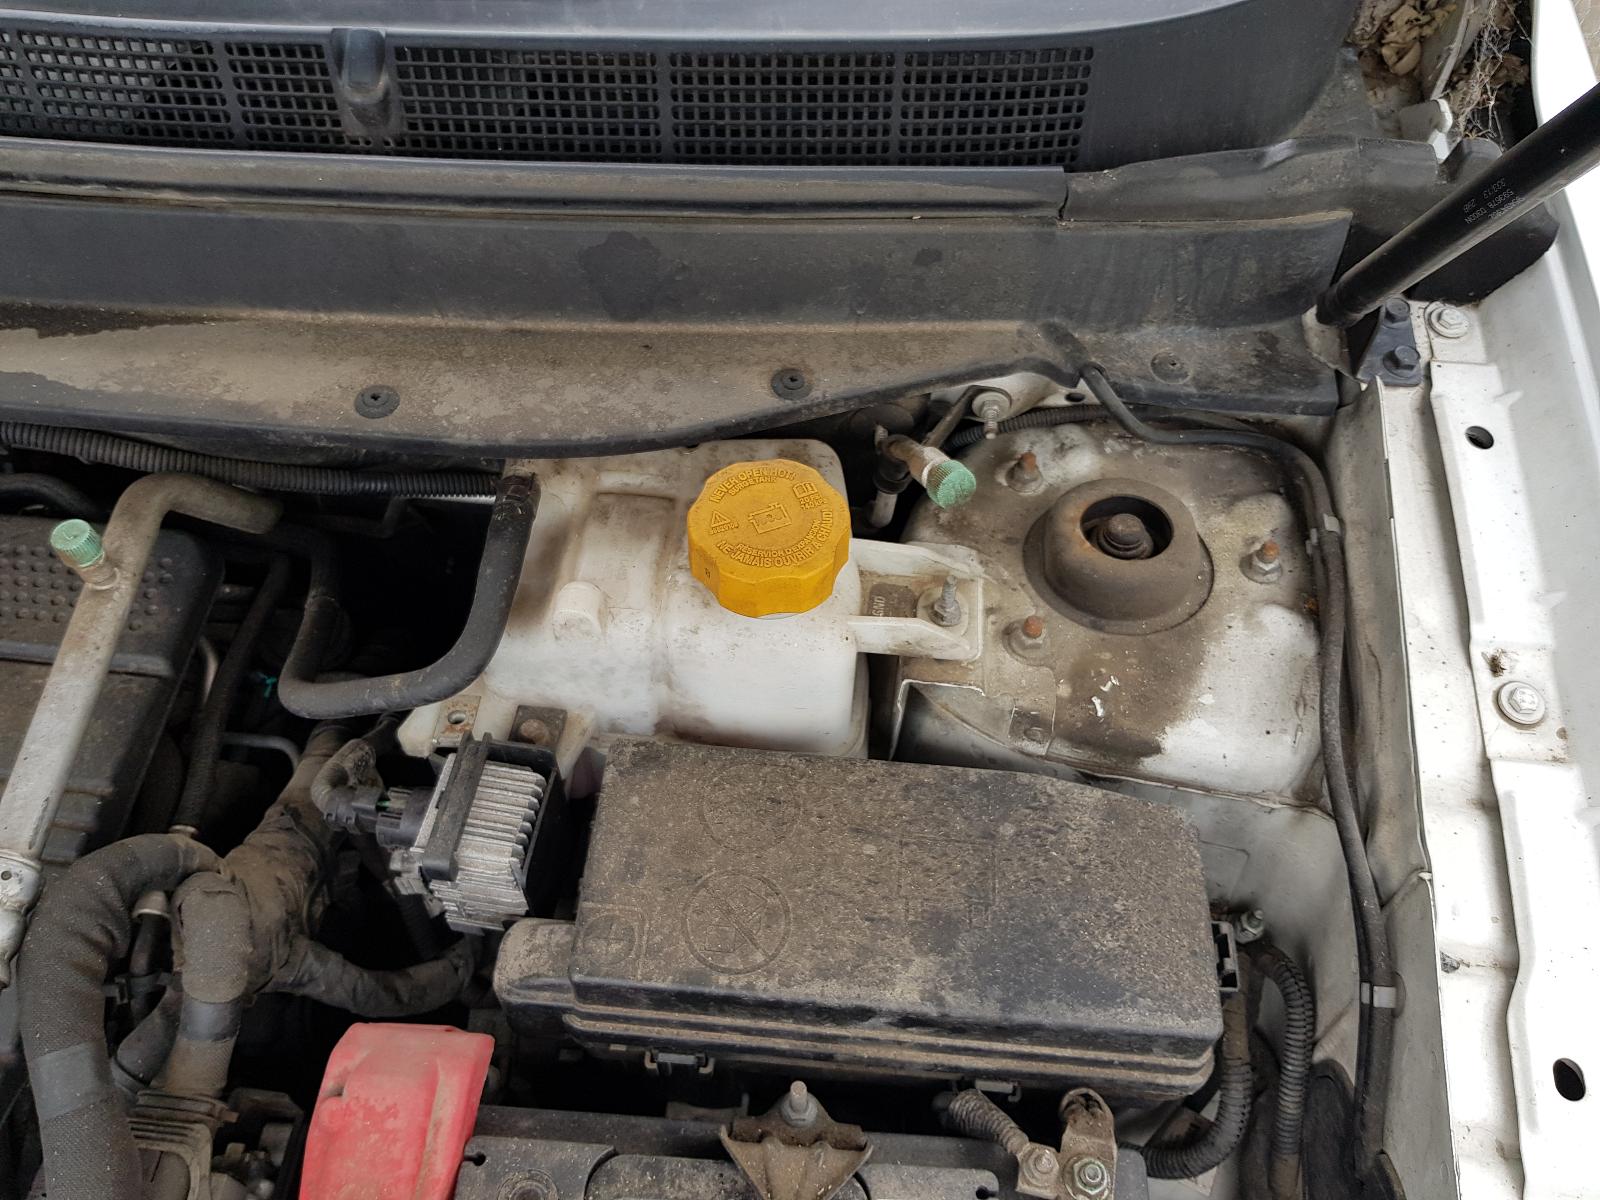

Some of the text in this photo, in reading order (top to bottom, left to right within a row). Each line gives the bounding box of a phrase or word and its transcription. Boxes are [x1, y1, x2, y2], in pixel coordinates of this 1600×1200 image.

[709, 476, 738, 503] NEVER
[738, 467, 769, 481] OPEN
[728, 475, 777, 496] SURGE TANK
[716, 539, 733, 554] NE
[730, 550, 772, 568] JAMAIS
[774, 546, 815, 567] OUVRIR
[871, 595, 886, 616] GND
